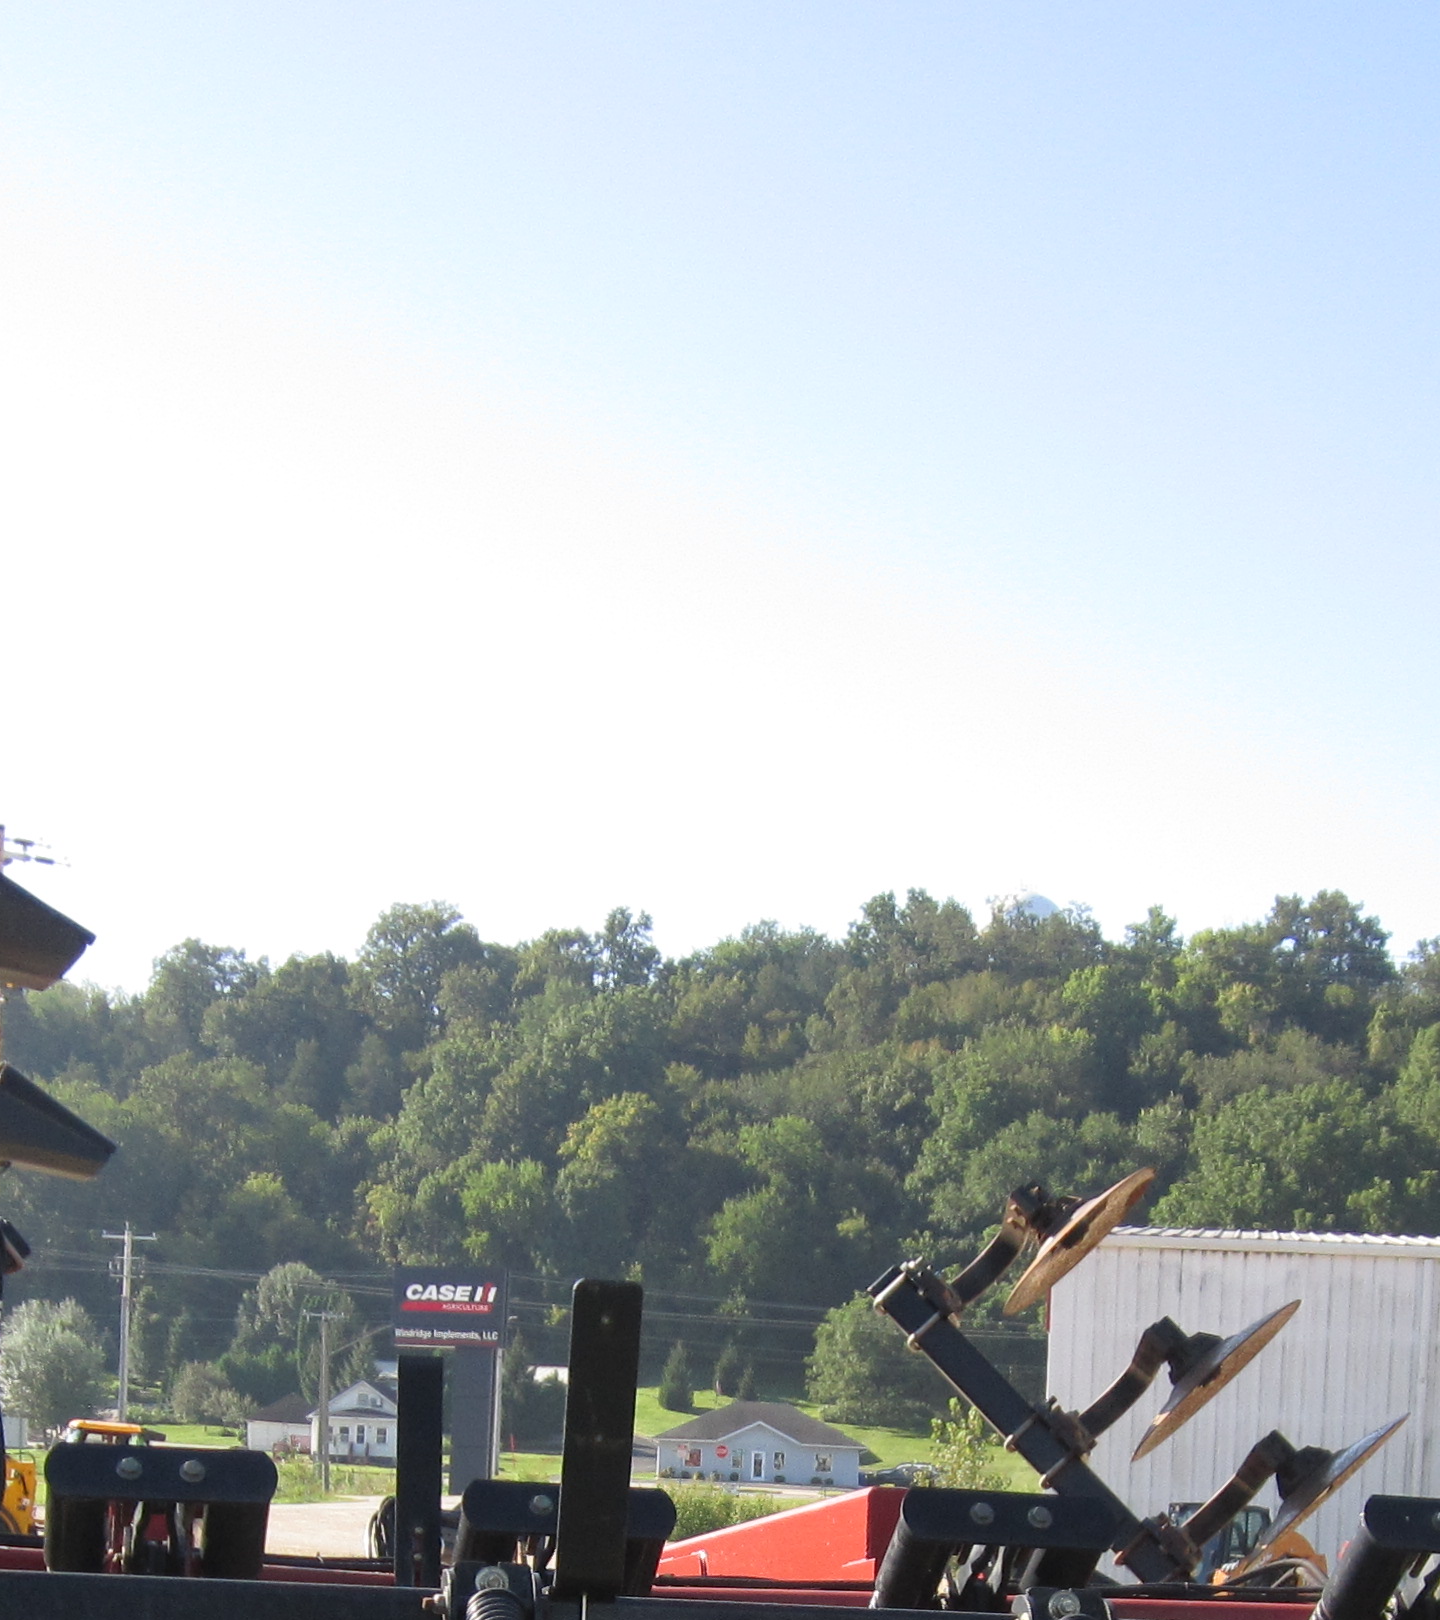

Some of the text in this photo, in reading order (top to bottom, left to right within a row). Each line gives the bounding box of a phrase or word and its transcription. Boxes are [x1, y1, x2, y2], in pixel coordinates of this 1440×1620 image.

[406, 1283, 472, 1302] CASE
[442, 1303, 489, 1312] AGRICULTURE
[395, 1328, 499, 1341] Windridge Implements, LLC
